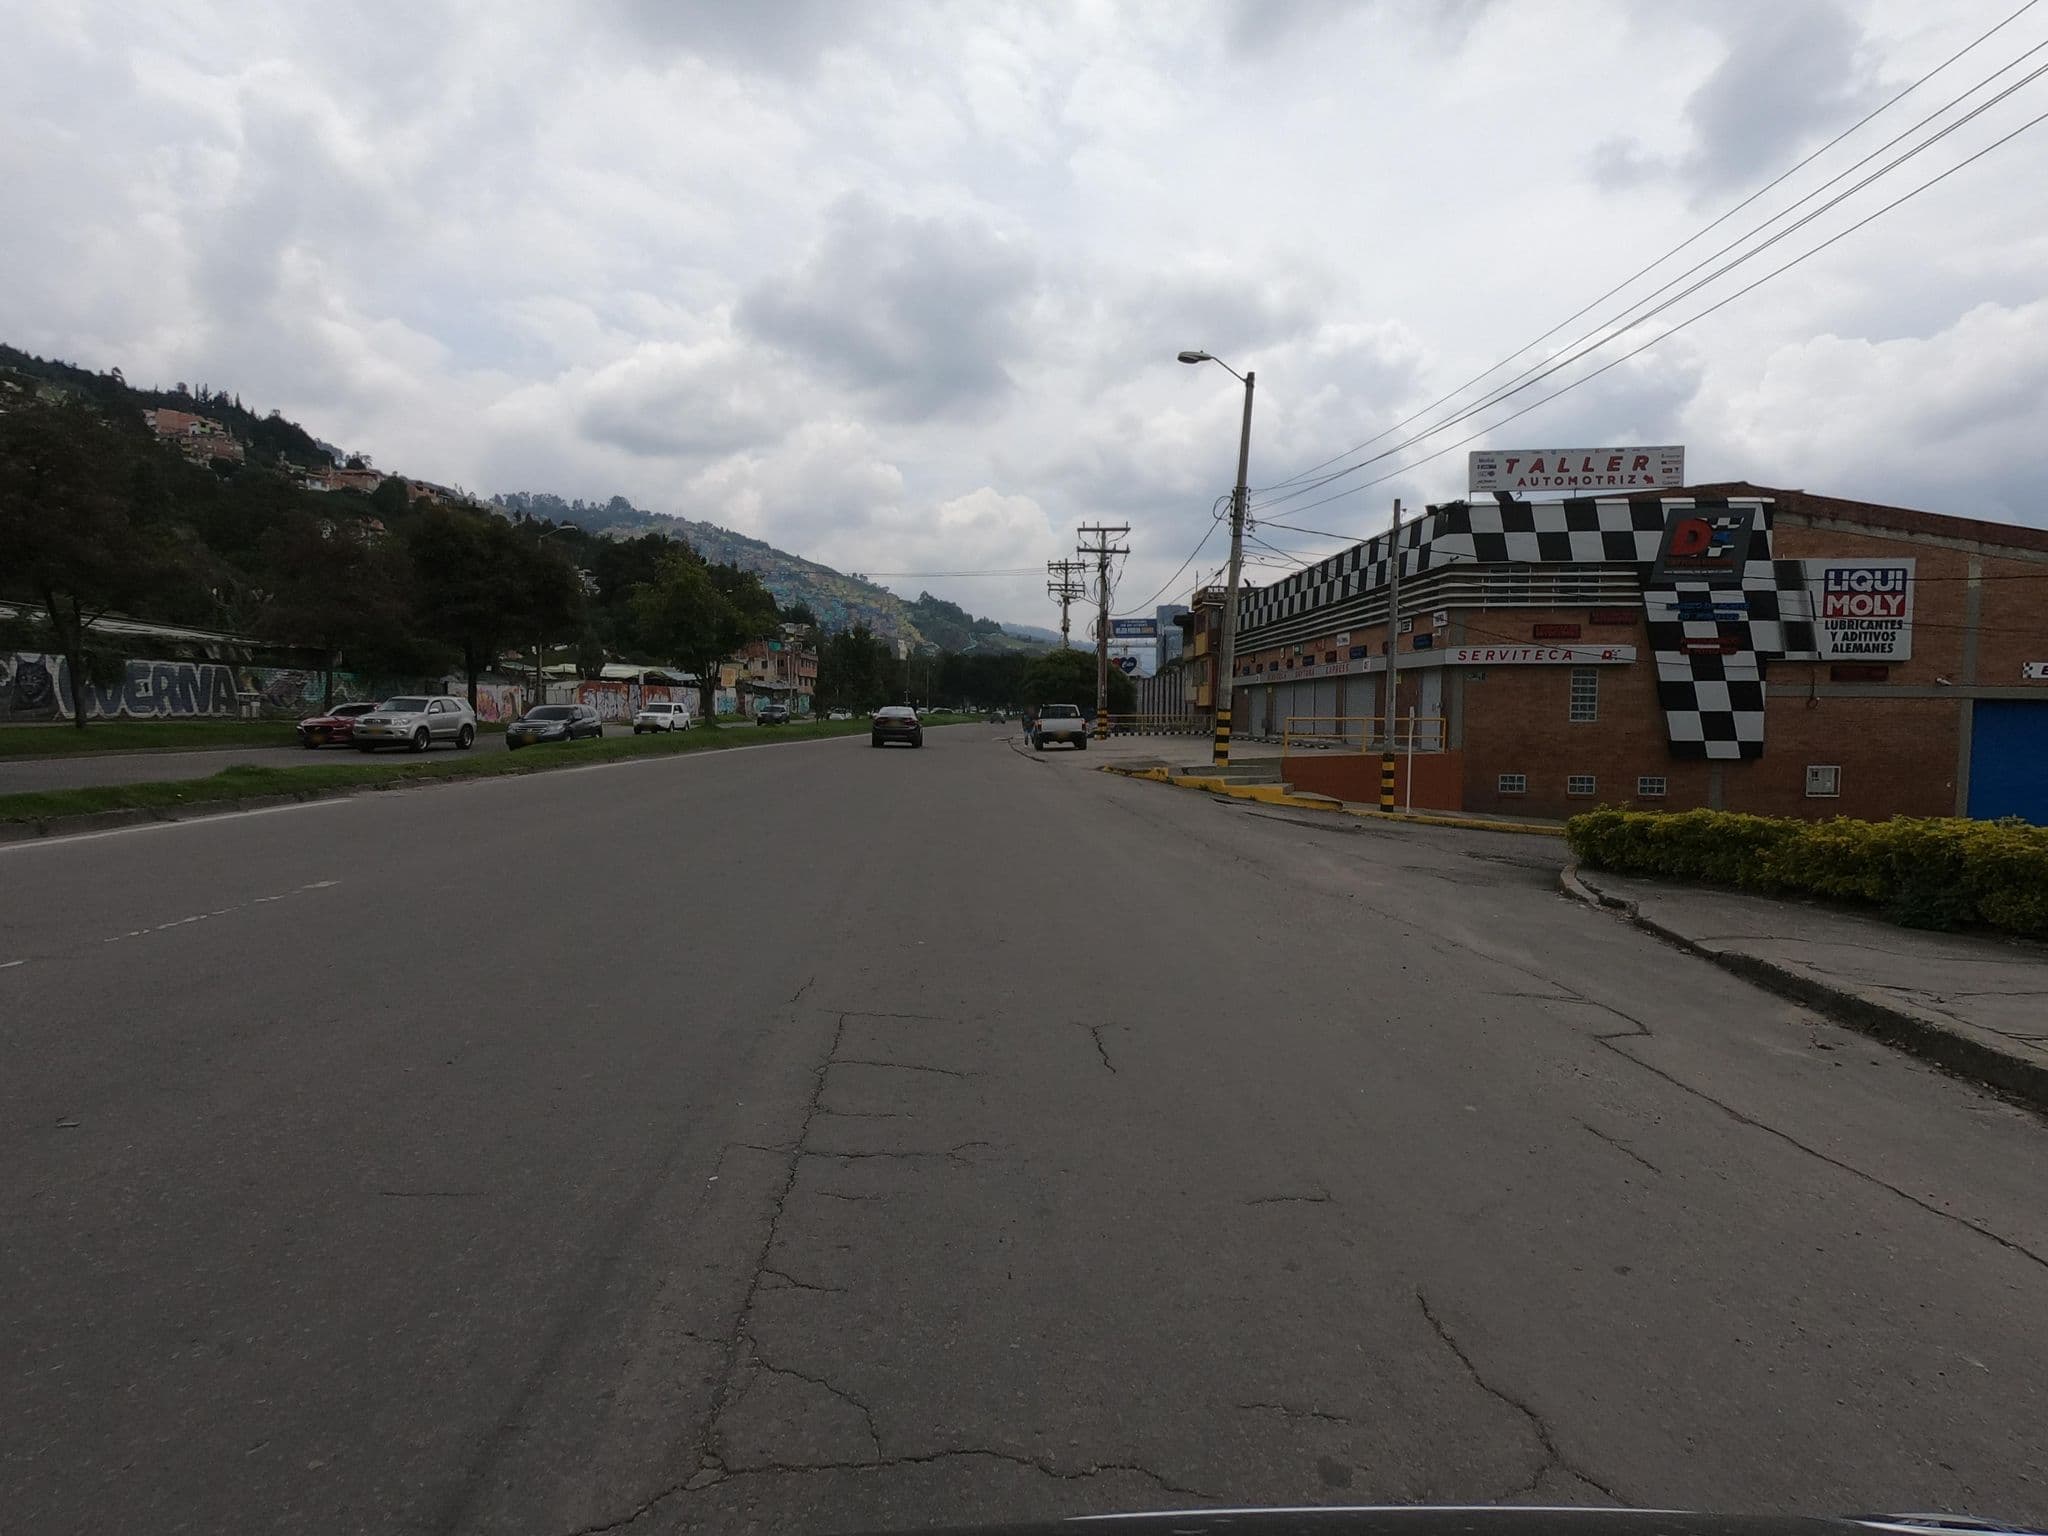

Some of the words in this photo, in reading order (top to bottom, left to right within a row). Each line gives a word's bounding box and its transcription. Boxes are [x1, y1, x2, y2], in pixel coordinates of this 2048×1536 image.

[1505, 455, 1650, 475] TALLER
[1517, 475, 1637, 487] AUTOMOTRIZ
[1827, 570, 1904, 592] LIQUI
[1826, 594, 1904, 616] MOLY
[1824, 619, 1904, 631] LUBRICANTES
[1831, 631, 1837, 642] Y
[1841, 631, 1897, 642] ADITIVOS
[1831, 643, 1894, 654] ALEMANES
[1457, 649, 1575, 662] SERVITECA
